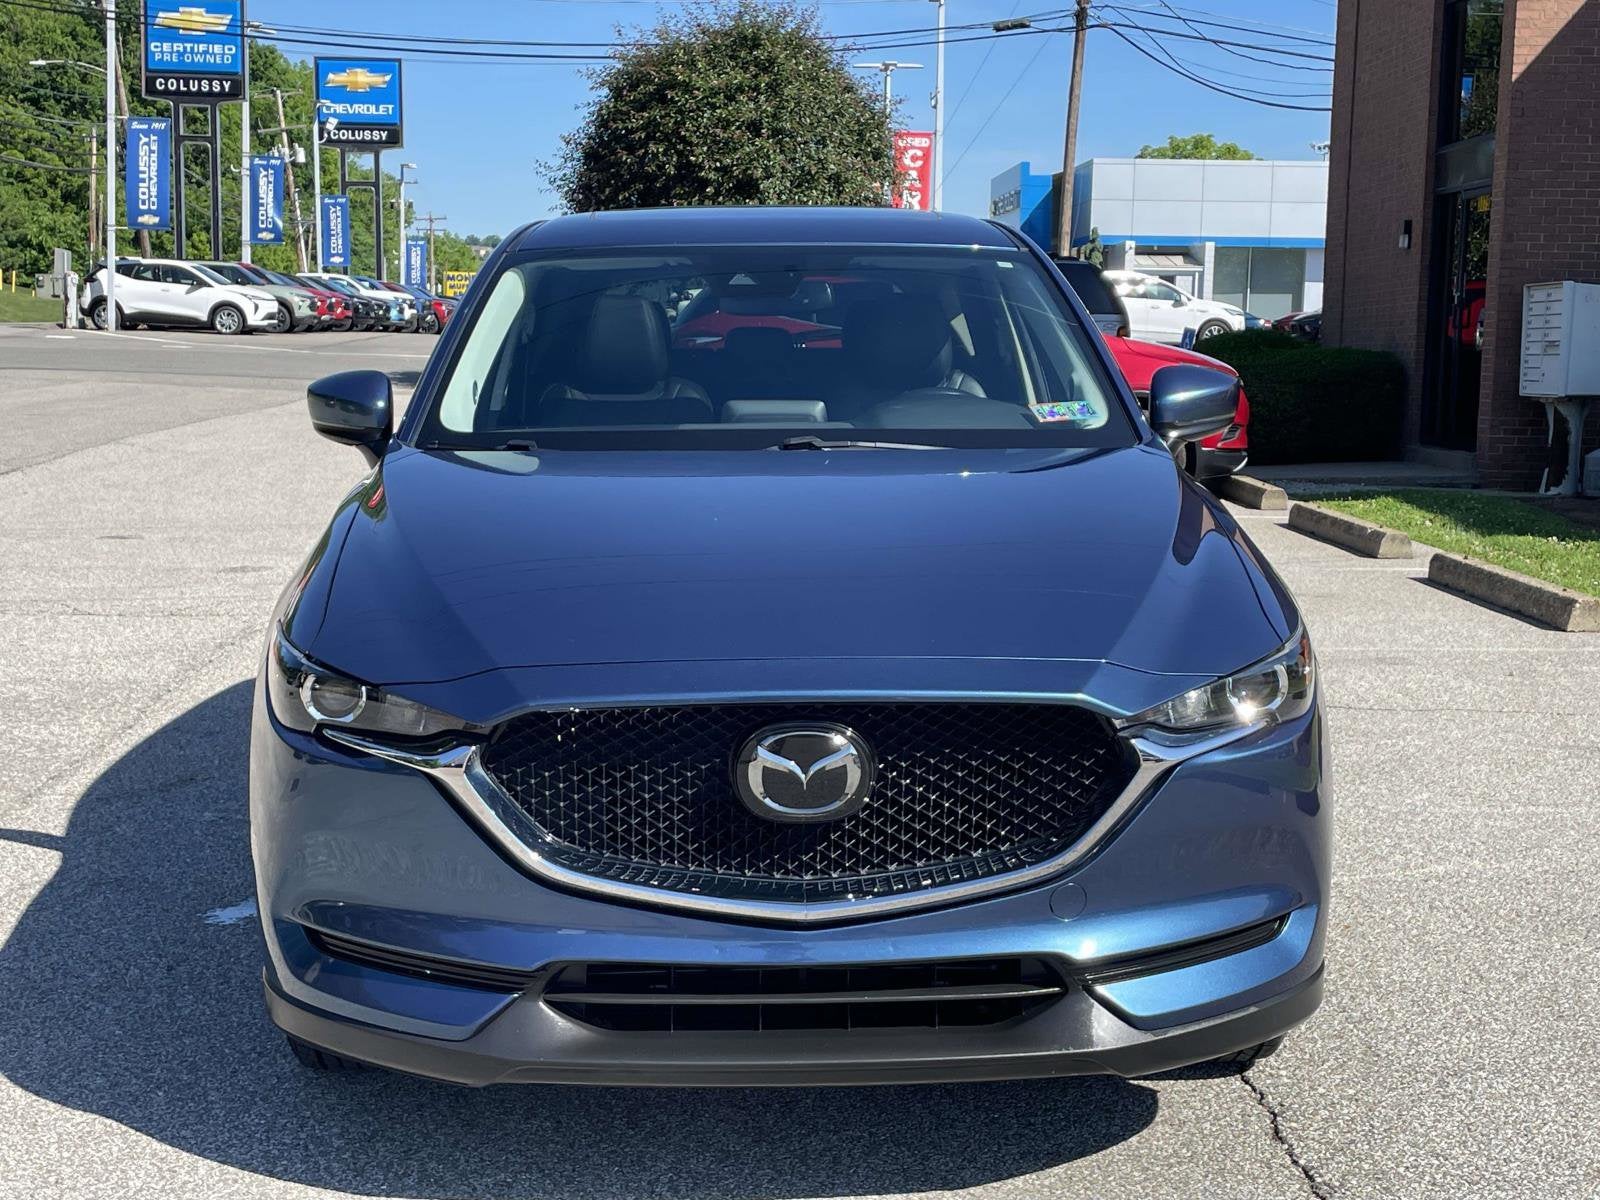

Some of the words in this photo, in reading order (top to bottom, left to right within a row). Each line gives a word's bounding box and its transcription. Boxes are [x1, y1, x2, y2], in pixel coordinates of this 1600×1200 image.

[150, 41, 236, 54] CERTIFIED
[154, 52, 232, 64] PRE-OWNED
[155, 78, 232, 92] COLUSSY
[322, 103, 395, 115] CHEVROLET
[330, 129, 388, 140] COLUSSY
[139, 133, 149, 209] COLUSSY
[149, 134, 158, 210] CHEVROLET
[258, 167, 267, 228] COLUSSY
[329, 205, 337, 253] COLUSSY
